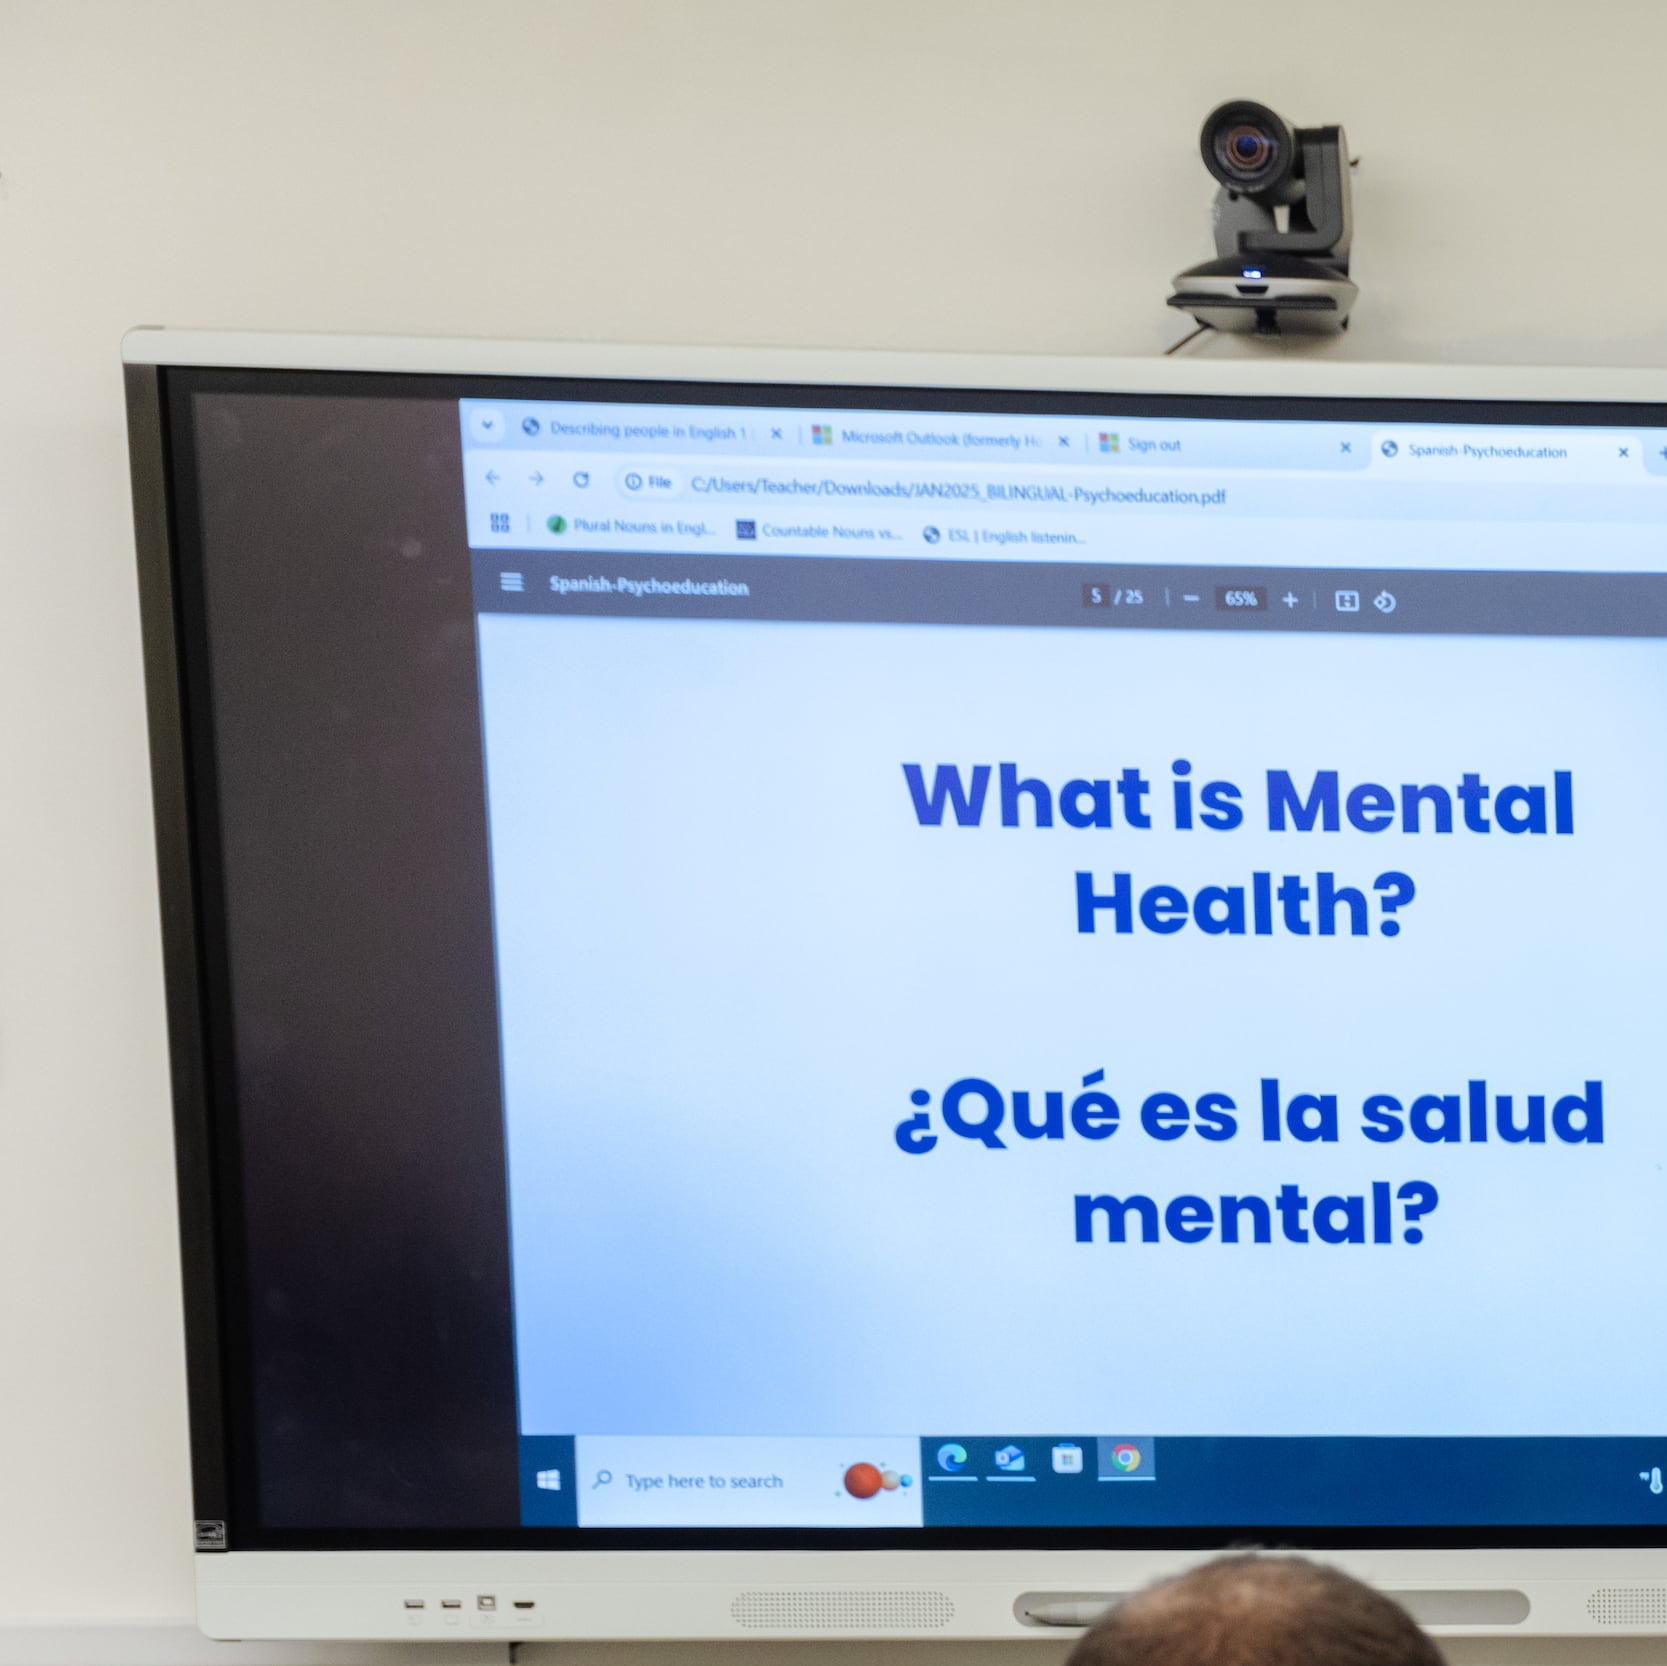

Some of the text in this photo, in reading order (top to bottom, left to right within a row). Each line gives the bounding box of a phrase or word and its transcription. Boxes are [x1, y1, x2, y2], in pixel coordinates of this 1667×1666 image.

[551, 421, 620, 439] Describing
[624, 424, 669, 441] people
[673, 425, 686, 438] in
[688, 426, 736, 442] English
[842, 430, 903, 445] Microsoft
[906, 432, 962, 446] Outlook
[964, 433, 1020, 450] (formerly
[1128, 437, 1182, 453] Sign out
[1409, 443, 1568, 460] Spanish-Psychoeducation
[649, 476, 672, 489] File
[574, 518, 610, 533] Plural
[614, 519, 657, 534] Nouns
[660, 520, 673, 534] in
[762, 523, 829, 539] Countable
[833, 525, 875, 540] Nouns
[948, 528, 970, 543] ESL
[982, 529, 1028, 546] English
[550, 574, 750, 597] Spanish-Psychoeducation
[1125, 590, 1144, 605] 25
[1224, 590, 1258, 607] 65%
[901, 760, 1573, 834] What is Mental
[1076, 872, 1415, 937] Health?
[895, 1069, 1603, 1154] ¿Qué es la salud
[1075, 1181, 1438, 1244] mental?
[626, 1474, 784, 1492] Type here to search
